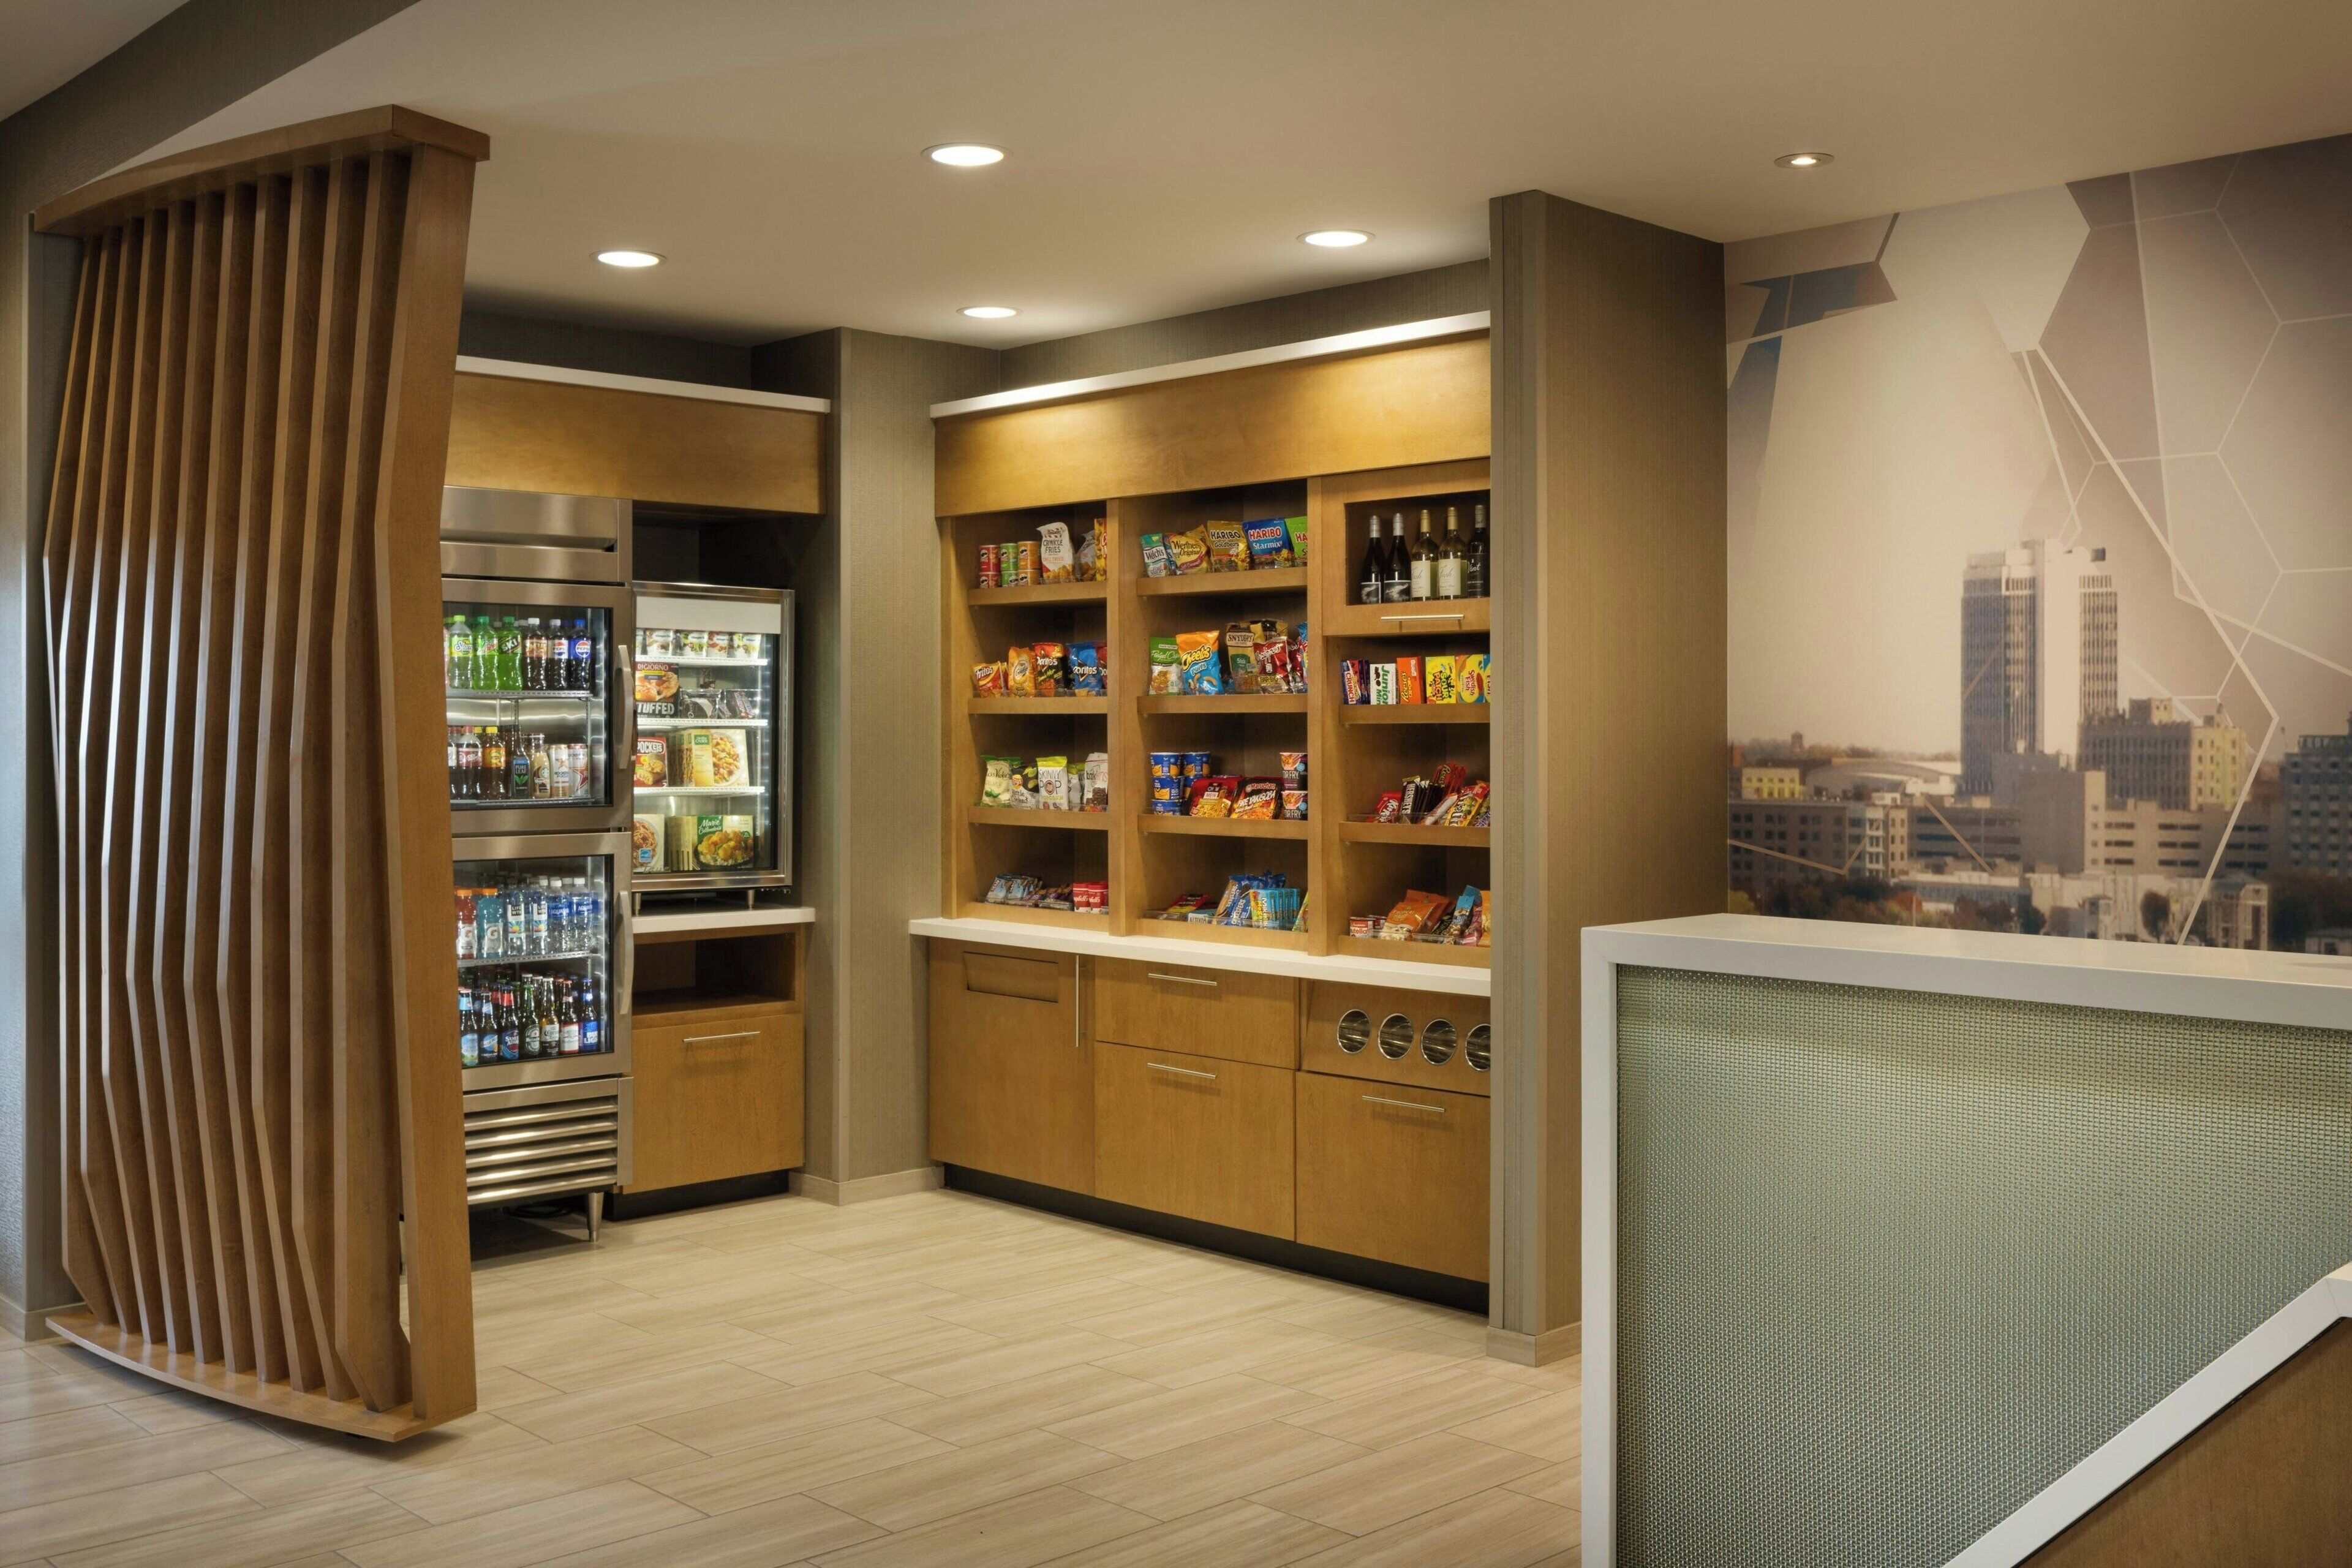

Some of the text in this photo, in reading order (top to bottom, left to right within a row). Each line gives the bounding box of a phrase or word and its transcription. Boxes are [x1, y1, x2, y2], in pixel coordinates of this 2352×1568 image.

[1210, 530, 1240, 540] HARIBO
[1249, 527, 1281, 540] HARIBO
[1145, 548, 1165, 560] Welch's
[502, 638, 518, 651] SKI
[1182, 645, 1212, 671] Cheetos
[1346, 673, 1355, 702] CRUNCH
[1381, 665, 1390, 704] Junior
[1433, 672, 1442, 701] PATCH
[1441, 672, 1449, 699] SOUR
[637, 703, 674, 714] TUFFED
[637, 742, 663, 753] POCKETS
[1038, 769, 1060, 780] SKINNY
[1039, 780, 1061, 795] POP
[1402, 783, 1415, 815] HERSHEY'S
[699, 820, 720, 829] Marie
